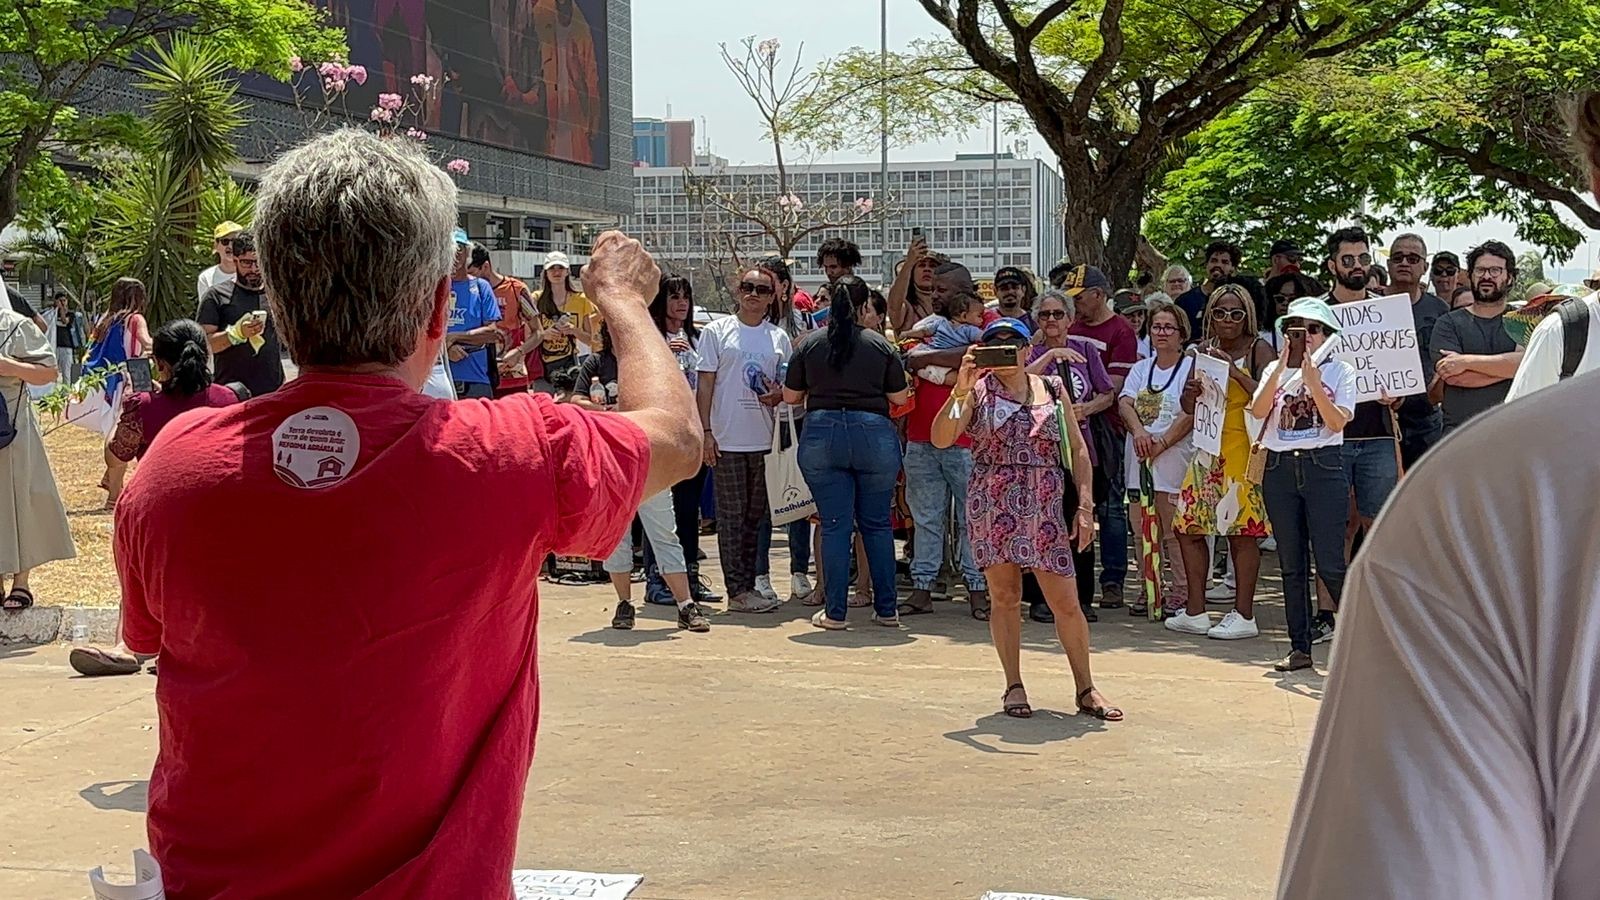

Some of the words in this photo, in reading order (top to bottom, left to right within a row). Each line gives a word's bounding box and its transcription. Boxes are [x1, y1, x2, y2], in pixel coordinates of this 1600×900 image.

[1332, 304, 1383, 328] VIDAS
[1355, 355, 1376, 370] DE
[1355, 369, 1418, 394] CLÁVEIS
[1194, 401, 1219, 440] GRAS
[279, 441, 307, 450] REFORMA
